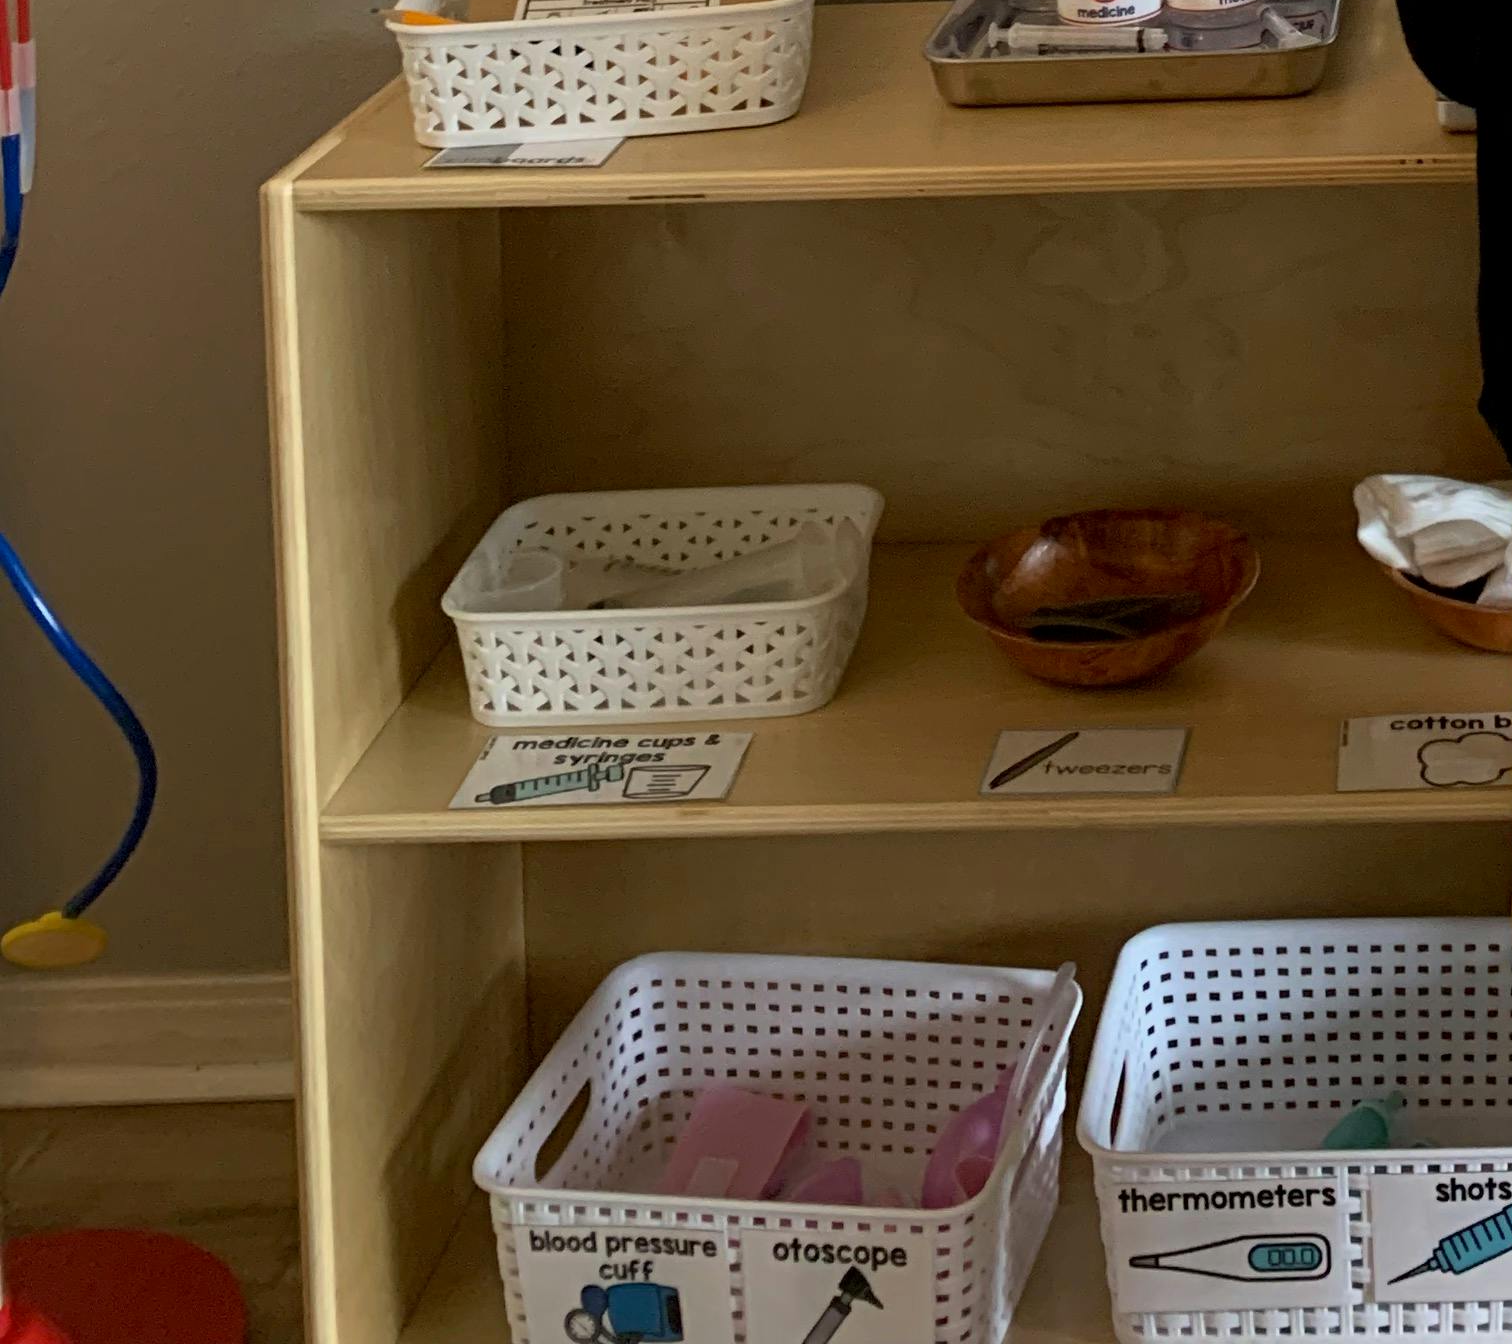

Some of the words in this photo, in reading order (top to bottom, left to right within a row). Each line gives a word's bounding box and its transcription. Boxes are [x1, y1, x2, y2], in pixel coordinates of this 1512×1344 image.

[1077, 5, 1136, 18] medicine
[1390, 715, 1485, 730] cotton
[512, 736, 629, 750] medicine
[637, 735, 695, 748] cups
[704, 733, 721, 746] &
[553, 750, 667, 765] syringes
[1044, 761, 1172, 775] tweezers
[1119, 1185, 1336, 1213] thermometers
[1436, 1176, 1512, 1203] shots
[529, 1230, 597, 1255] blood
[605, 1233, 718, 1261] pressure
[773, 1238, 907, 1268] otoscope
[599, 1260, 654, 1281] cuff
